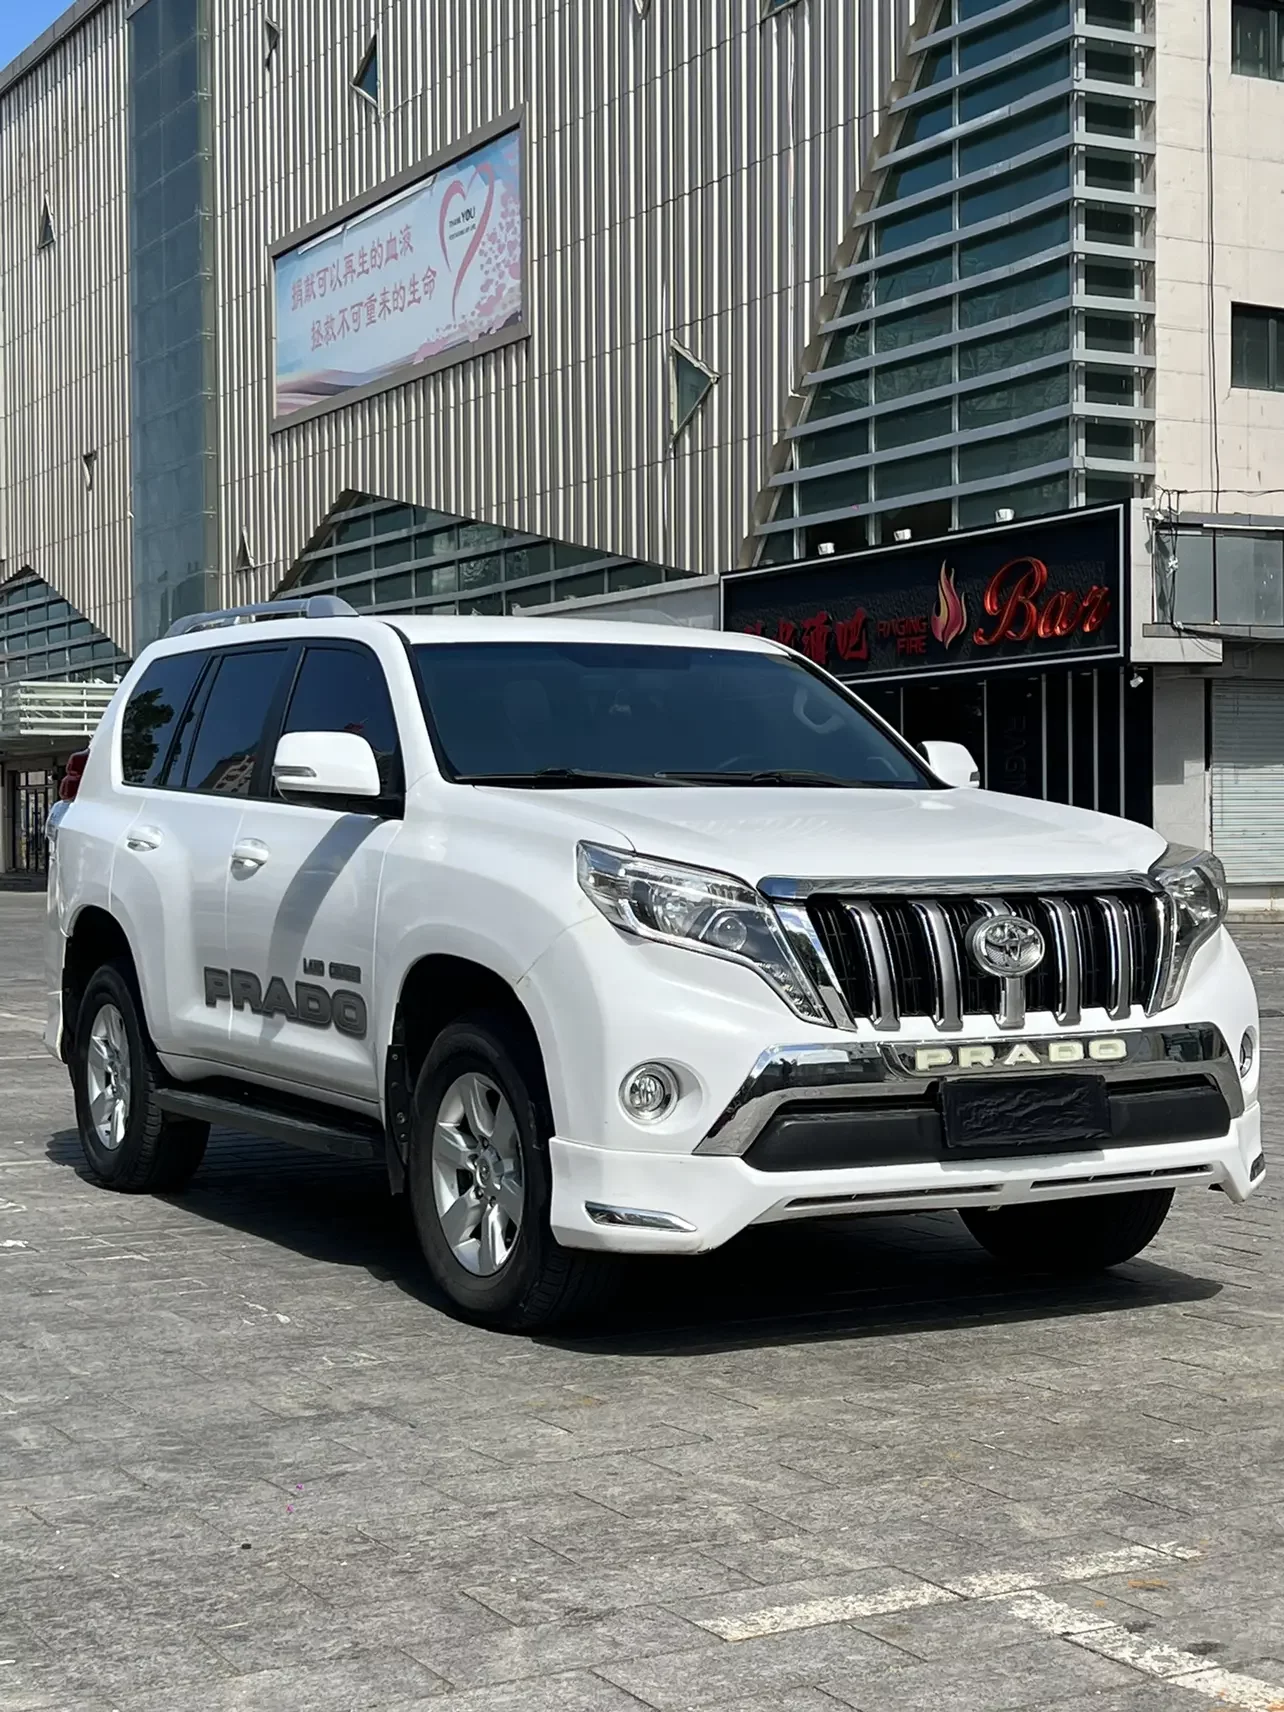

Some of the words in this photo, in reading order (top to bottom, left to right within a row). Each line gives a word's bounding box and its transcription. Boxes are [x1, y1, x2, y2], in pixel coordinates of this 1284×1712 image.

[461, 205, 476, 223] YOU
[291, 223, 414, 312] 捐献可以再生的血液
[311, 265, 437, 352] 拯救不可重来的生命
[876, 615, 928, 638] RAGING
[973, 556, 1111, 645] Bar
[896, 635, 927, 656] FIRE
[204, 966, 368, 1040] PRADO
[914, 1038, 1128, 1072] PRADO
